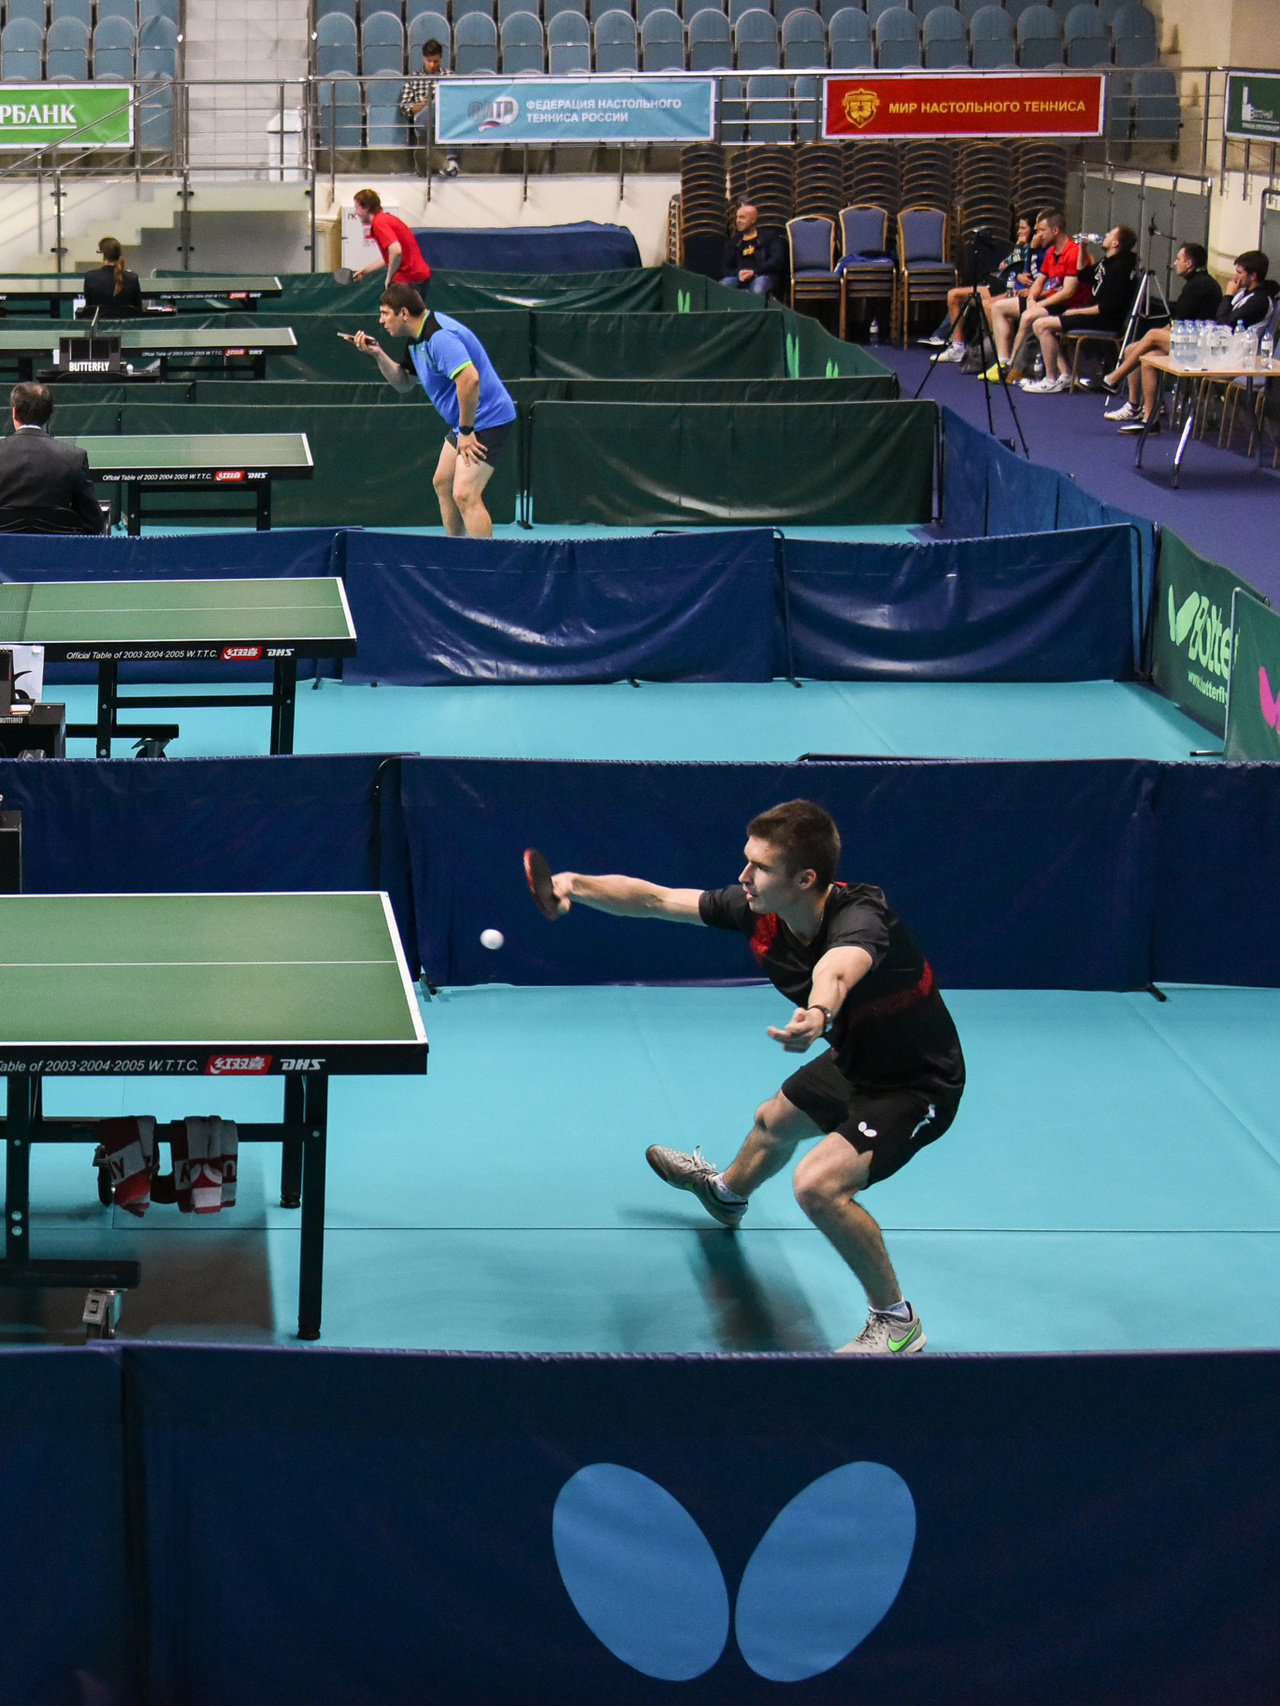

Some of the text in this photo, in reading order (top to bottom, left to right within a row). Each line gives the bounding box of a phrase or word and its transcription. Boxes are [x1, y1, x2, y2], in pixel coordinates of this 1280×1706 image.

[526, 99, 596, 111] ФЕДЕРАЦИЯ
[598, 99, 682, 110] НАСТОЛЬНОГО
[889, 100, 1086, 114] МИР НАСТОЛЬНОГО ТЕННИСА
[527, 112, 629, 124] ТЕННИСА РОССИИ
[69, 361, 110, 372] BUTTERFLY
[66, 651, 91, 660] Official
[92, 651, 112, 659] Table
[114, 650, 123, 659] of
[186, 649, 218, 658] W.T.T.C.
[266, 648, 295, 657] DHS
[29, 1060, 44, 1072] of
[148, 1059, 199, 1072] W.T.T.C.
[280, 1058, 326, 1071] DHS
